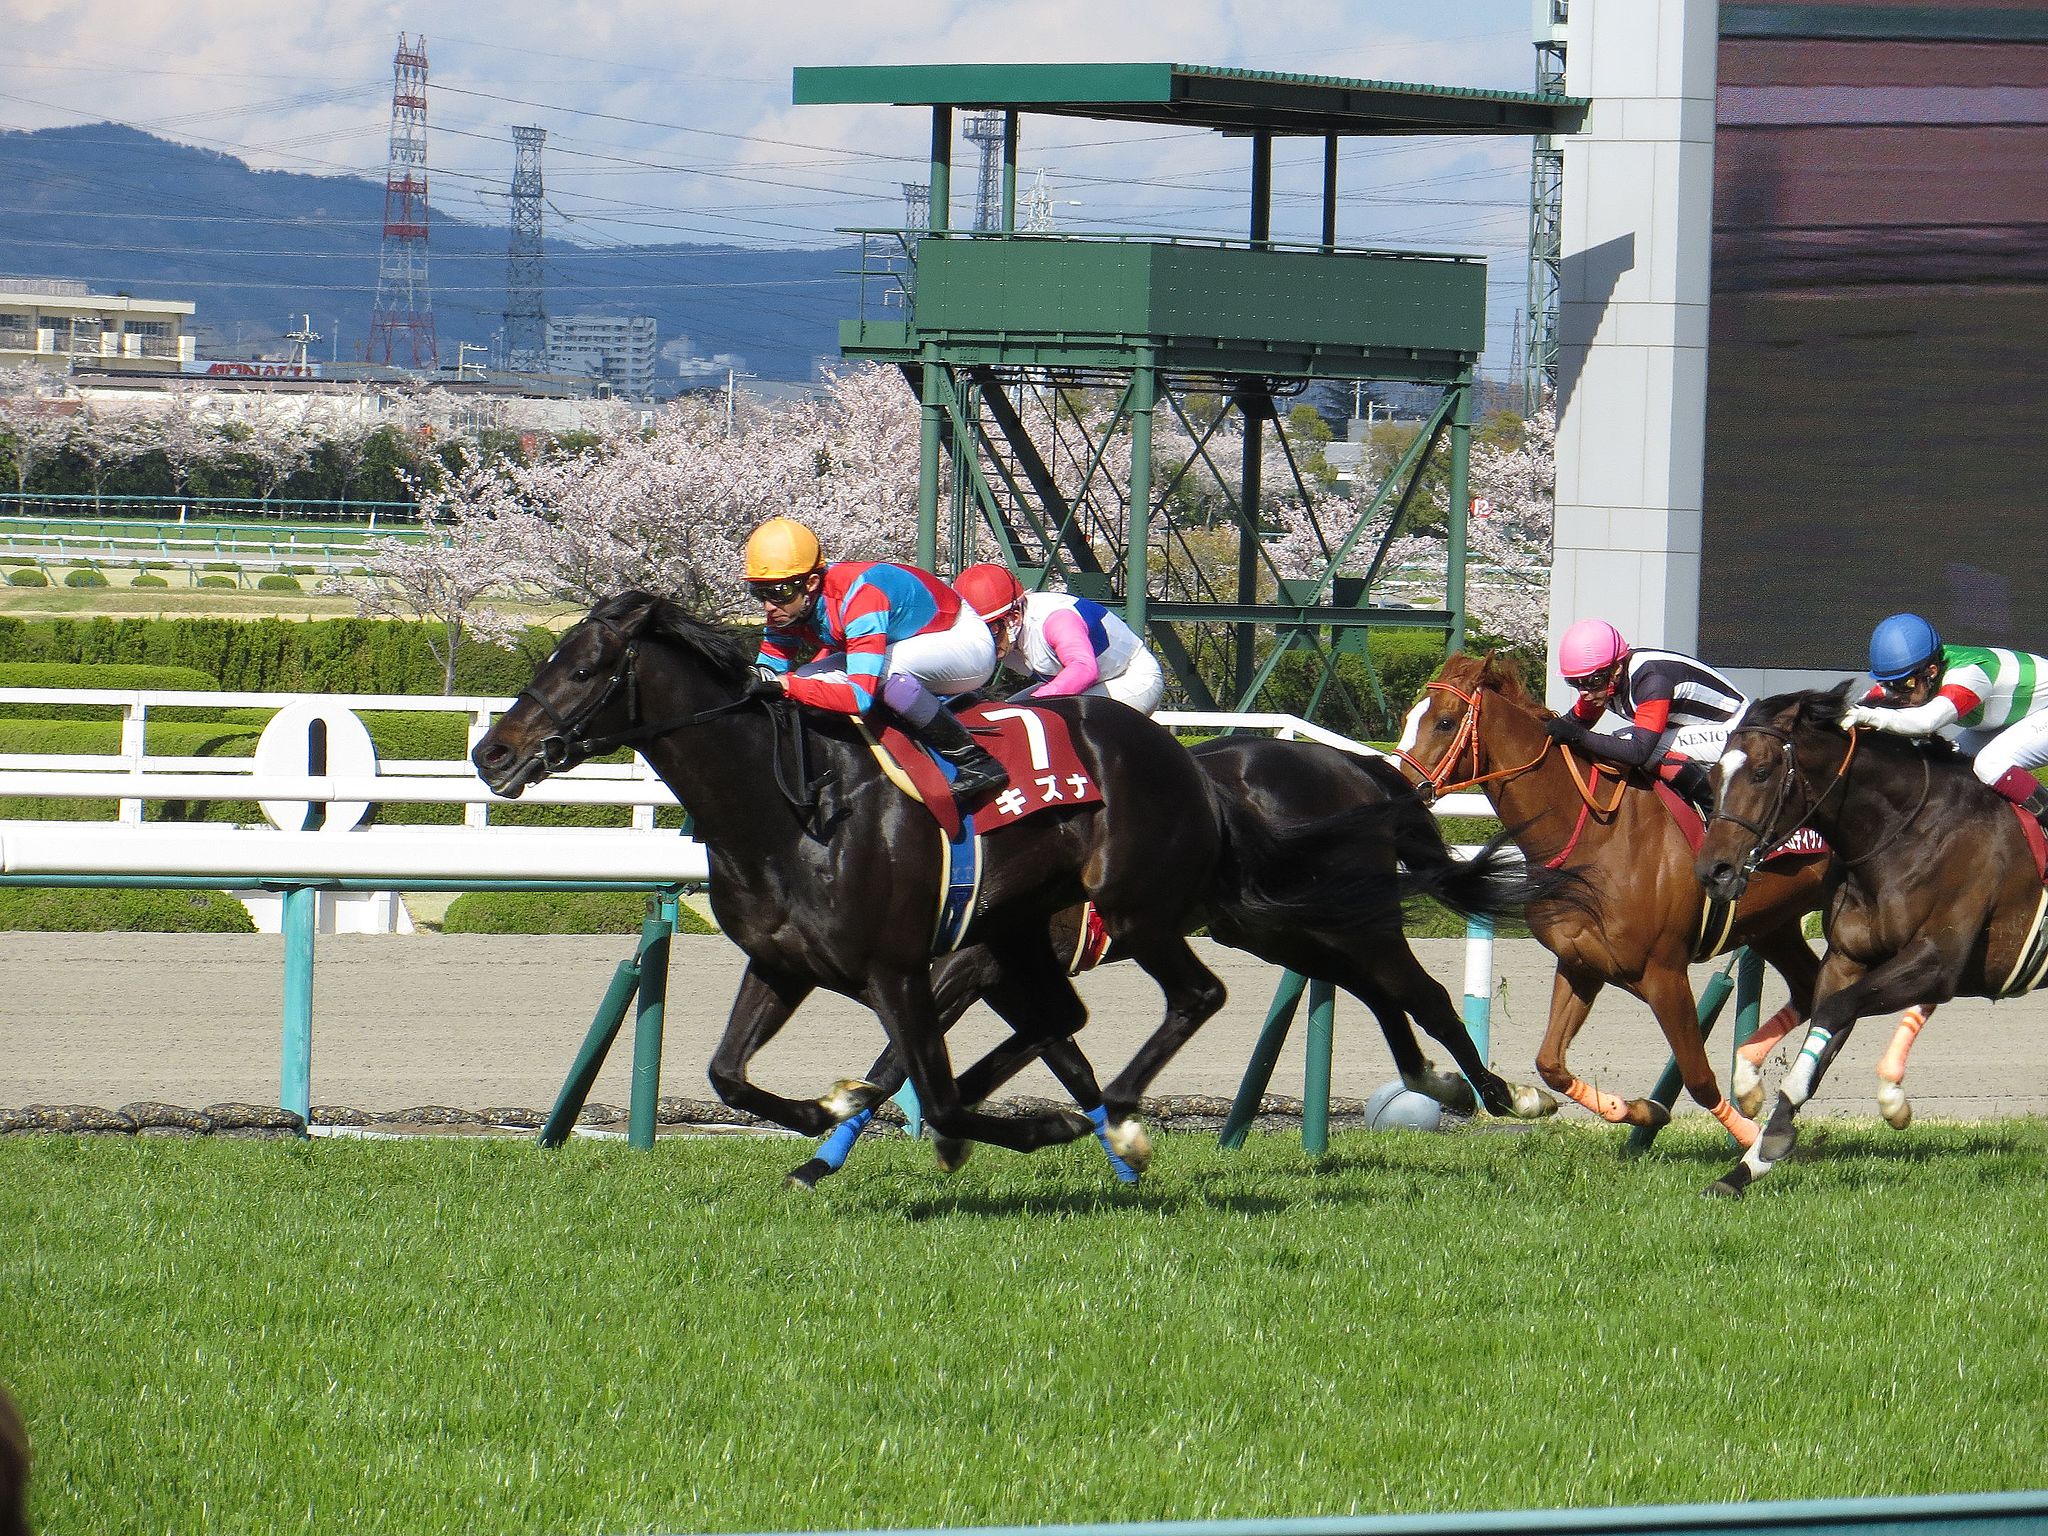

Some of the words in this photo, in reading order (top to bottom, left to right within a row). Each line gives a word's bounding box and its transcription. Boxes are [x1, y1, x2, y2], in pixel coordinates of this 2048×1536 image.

[980, 707, 1050, 770] 7
[1677, 730, 1729, 746] KENIC
[994, 773, 1089, 816] キズナ
